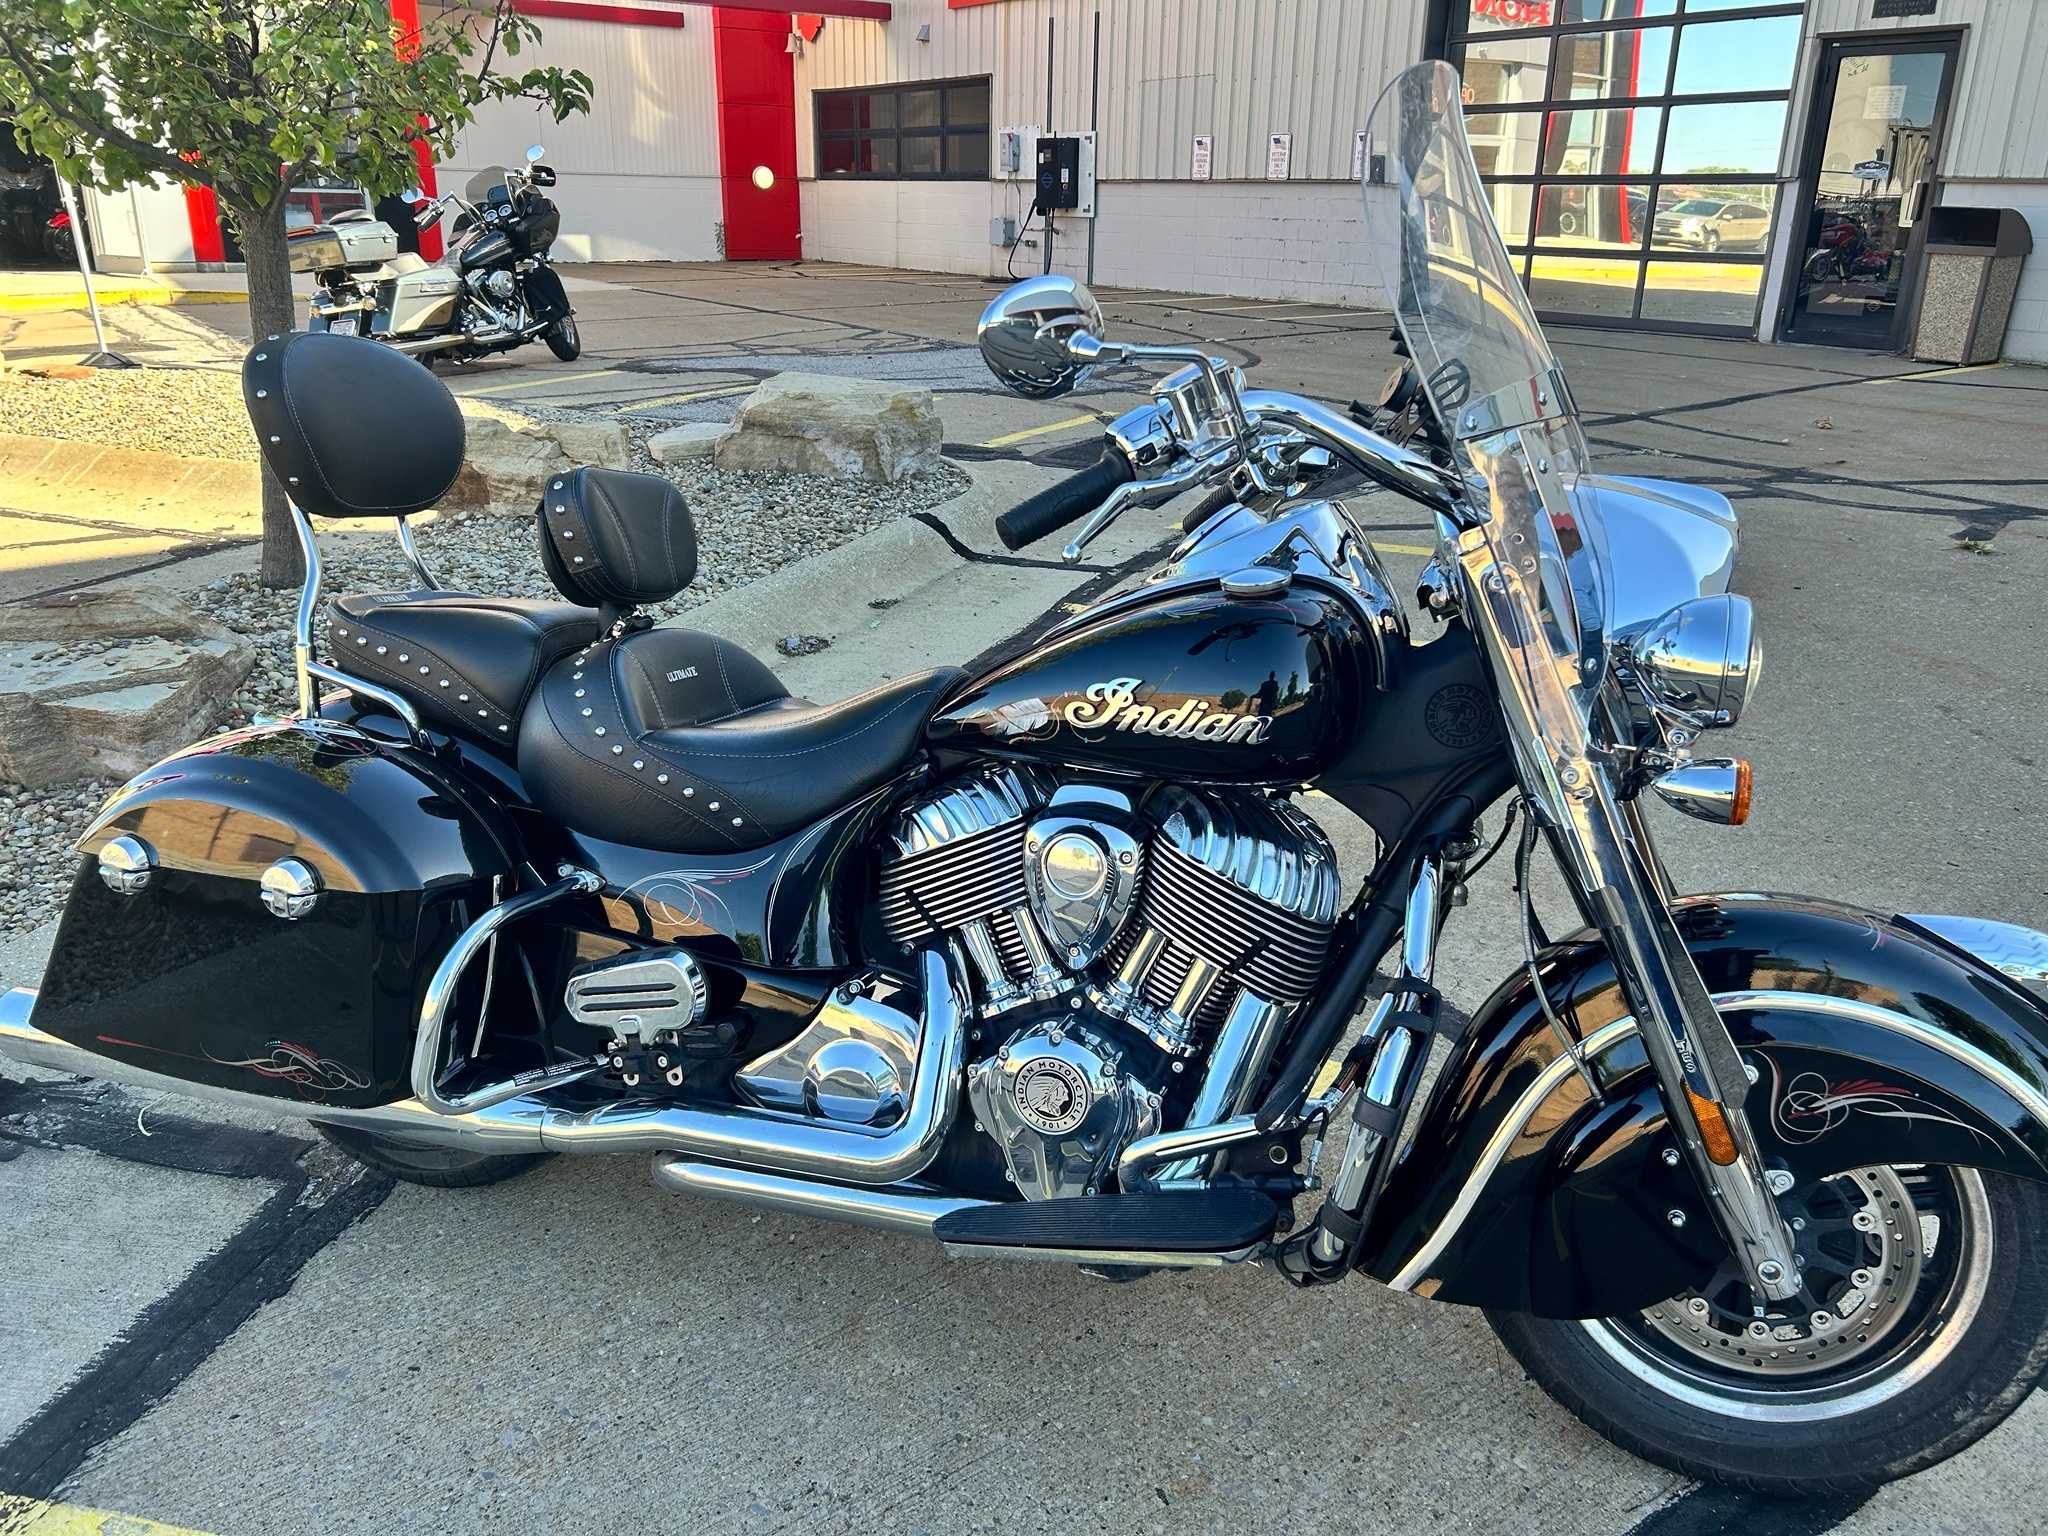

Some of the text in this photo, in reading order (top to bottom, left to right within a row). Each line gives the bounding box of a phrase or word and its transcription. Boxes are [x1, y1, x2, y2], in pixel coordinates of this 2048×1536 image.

[666, 666, 698, 682] ULTIMATE
[1064, 677, 1273, 745] Indian
[1018, 1061, 1083, 1122] INDIAN MOTORCYCLE
[1035, 1118, 1060, 1129] 1901
